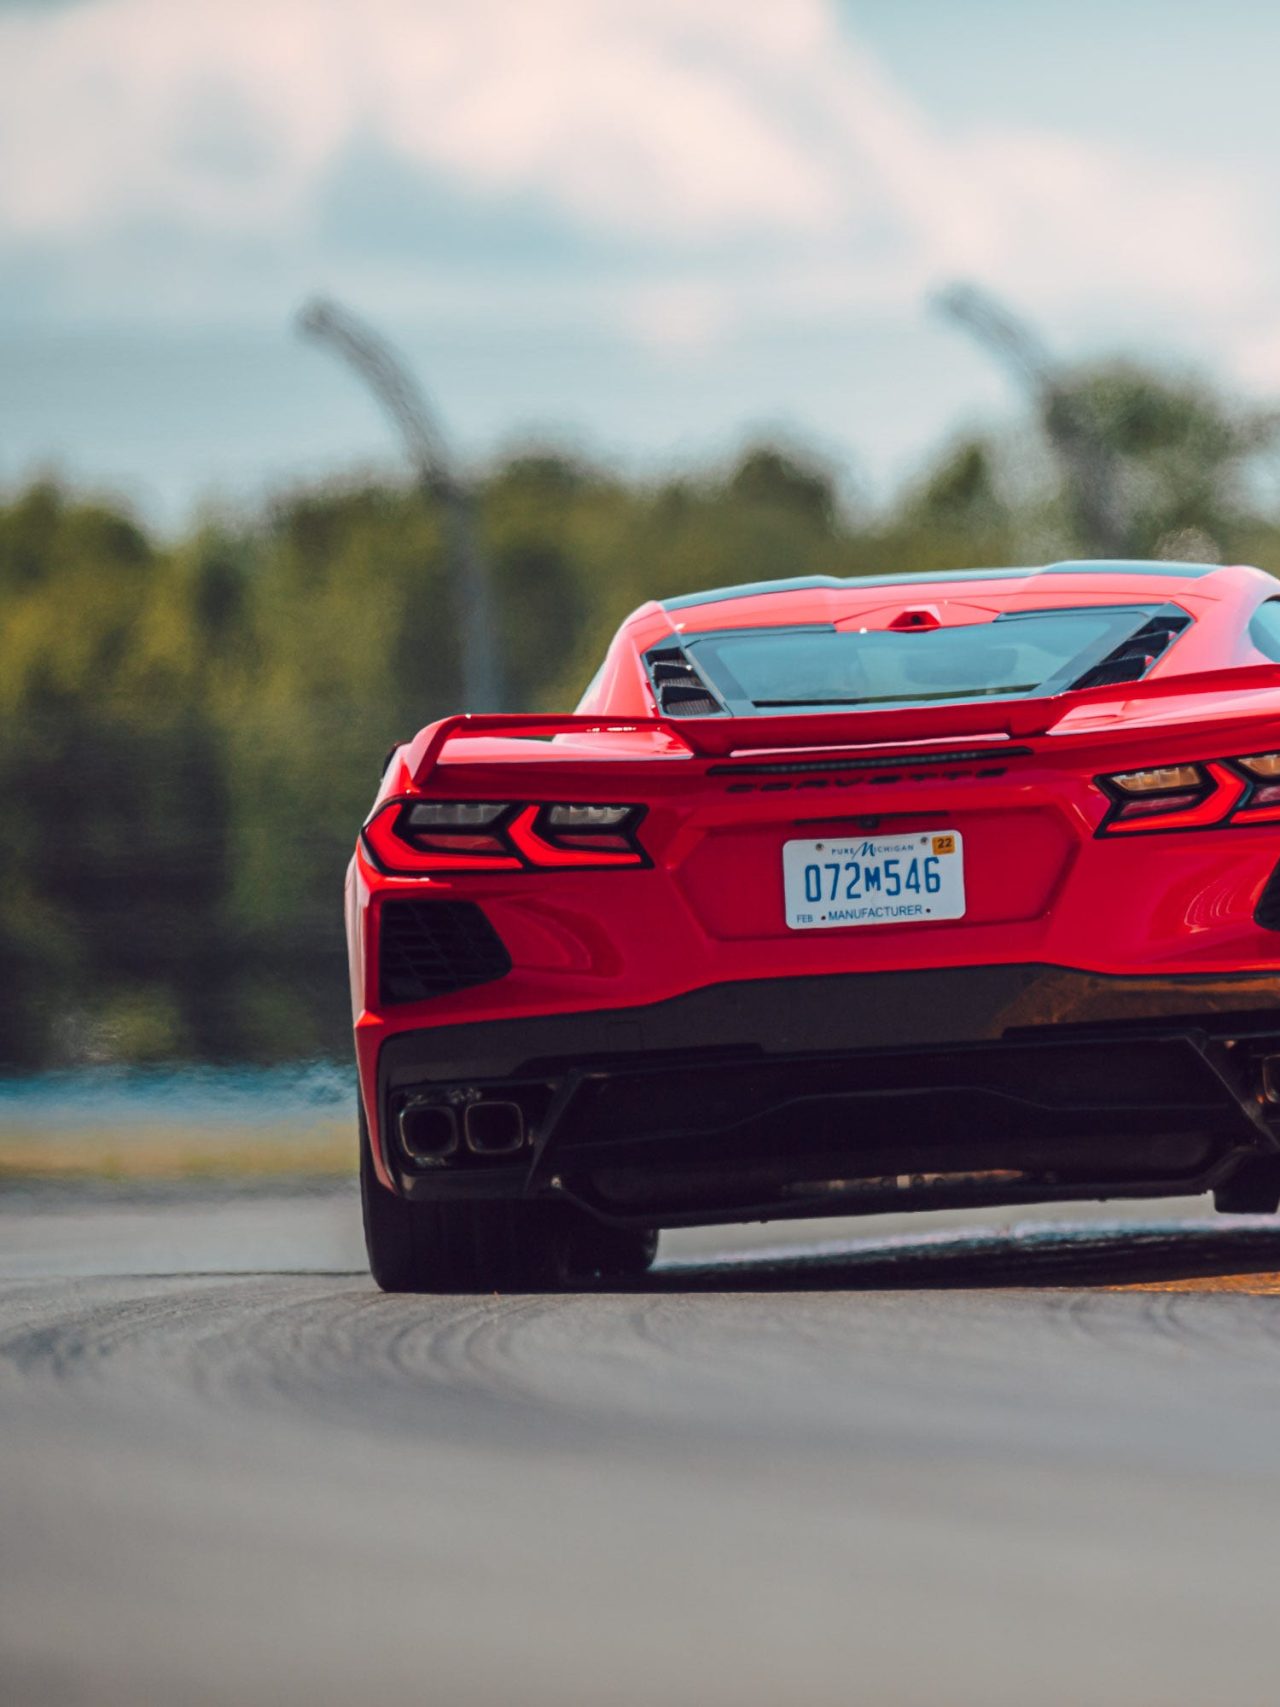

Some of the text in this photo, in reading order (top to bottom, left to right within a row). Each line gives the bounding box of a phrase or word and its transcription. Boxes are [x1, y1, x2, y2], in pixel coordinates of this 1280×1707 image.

[831, 842, 914, 858] PURE MICHIGAN
[937, 838, 953, 849] 22
[804, 857, 941, 902] 072M546
[796, 914, 814, 923] FEB
[828, 905, 923, 921] MANUFACTURER
